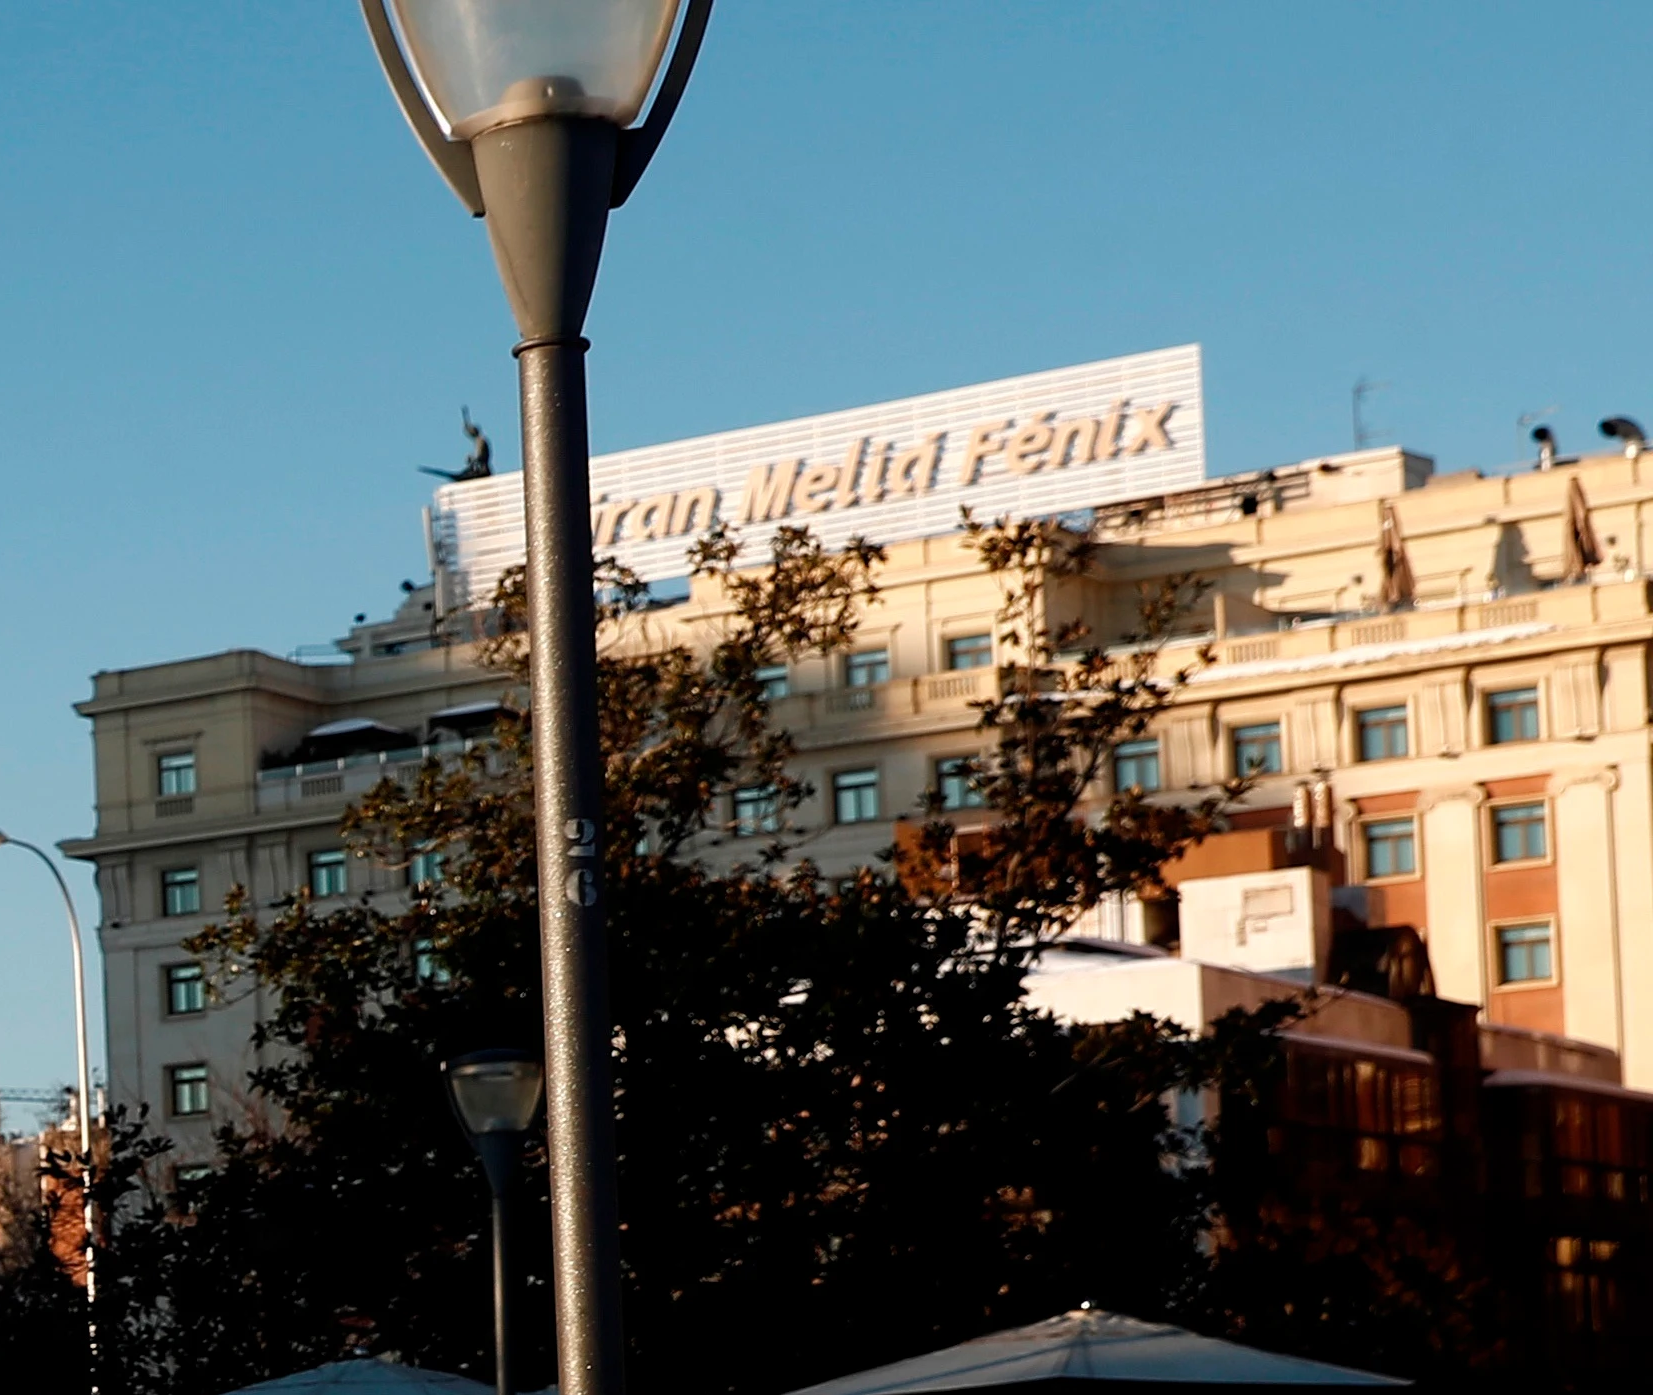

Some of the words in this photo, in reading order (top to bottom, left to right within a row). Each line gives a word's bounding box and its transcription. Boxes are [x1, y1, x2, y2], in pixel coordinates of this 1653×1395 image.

[593, 488, 718, 547] ran
[735, 430, 943, 526] Meliá
[959, 401, 1175, 486] Fénix
